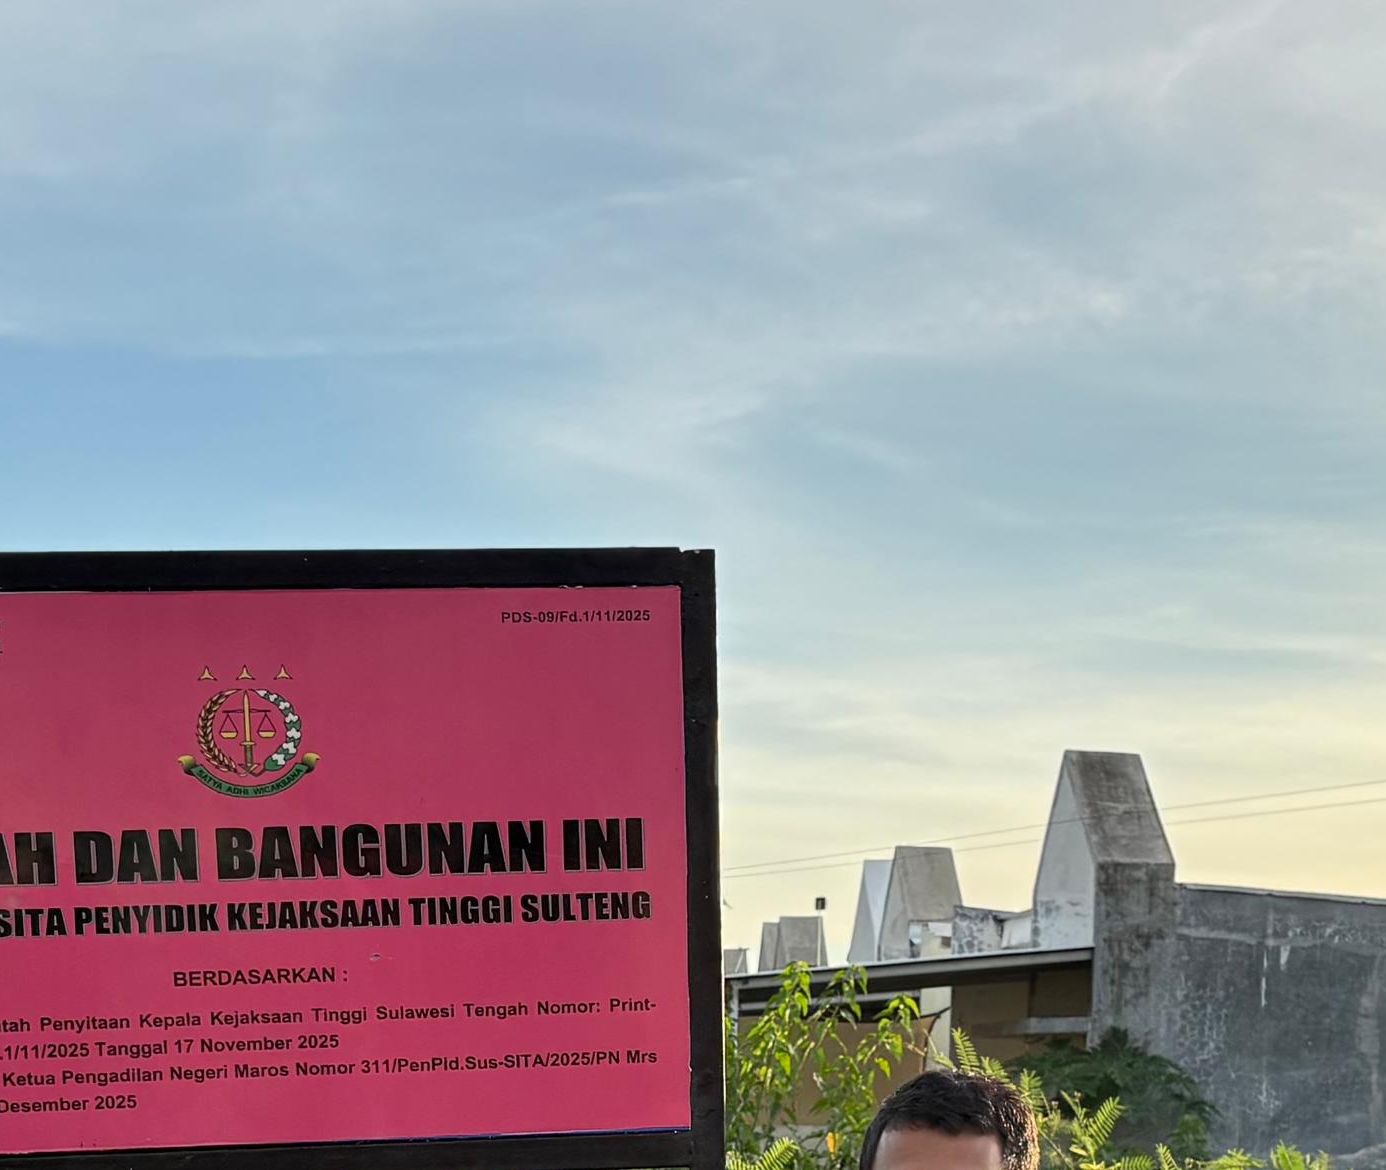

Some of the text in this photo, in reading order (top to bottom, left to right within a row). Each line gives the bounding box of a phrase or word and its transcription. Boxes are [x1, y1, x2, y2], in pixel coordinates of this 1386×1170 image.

[501, 610, 650, 624] PDS-09/Fd.1/11/2025
[73, 827, 200, 886] DAN
[215, 820, 547, 881] BANGUNAN
[562, 817, 645, 872] INI
[74, 903, 220, 936] PENYIDIK
[228, 898, 400, 931] KEJAKSAAN
[408, 895, 513, 926] TINGGI
[521, 890, 651, 924] SULTENG
[173, 968, 336, 987] BERDASARKAN
[40, 1015, 130, 1036] Penyitaan
[139, 1013, 201, 1032] Kepala
[210, 1008, 303, 1027] Kejaksaan
[312, 1007, 368, 1026] Tinggi
[376, 1004, 455, 1021] Sulawesi
[463, 1002, 528, 1019] Tengah
[537, 999, 601, 1016] Nomor:
[609, 997, 656, 1013] Print-
[95, 1040, 168, 1059] Tanggal
[175, 1039, 194, 1054] 17
[200, 1035, 292, 1052] November
[298, 1034, 339, 1050] 2025
[2, 1072, 56, 1088] Ketua
[61, 1068, 163, 1087] Pengadilan
[169, 1066, 228, 1084] Negeri
[234, 1063, 289, 1078] Maros
[295, 1061, 356, 1076] Nomor
[626, 1050, 658, 1065] Mrs
[94, 1094, 137, 1110] 2025
